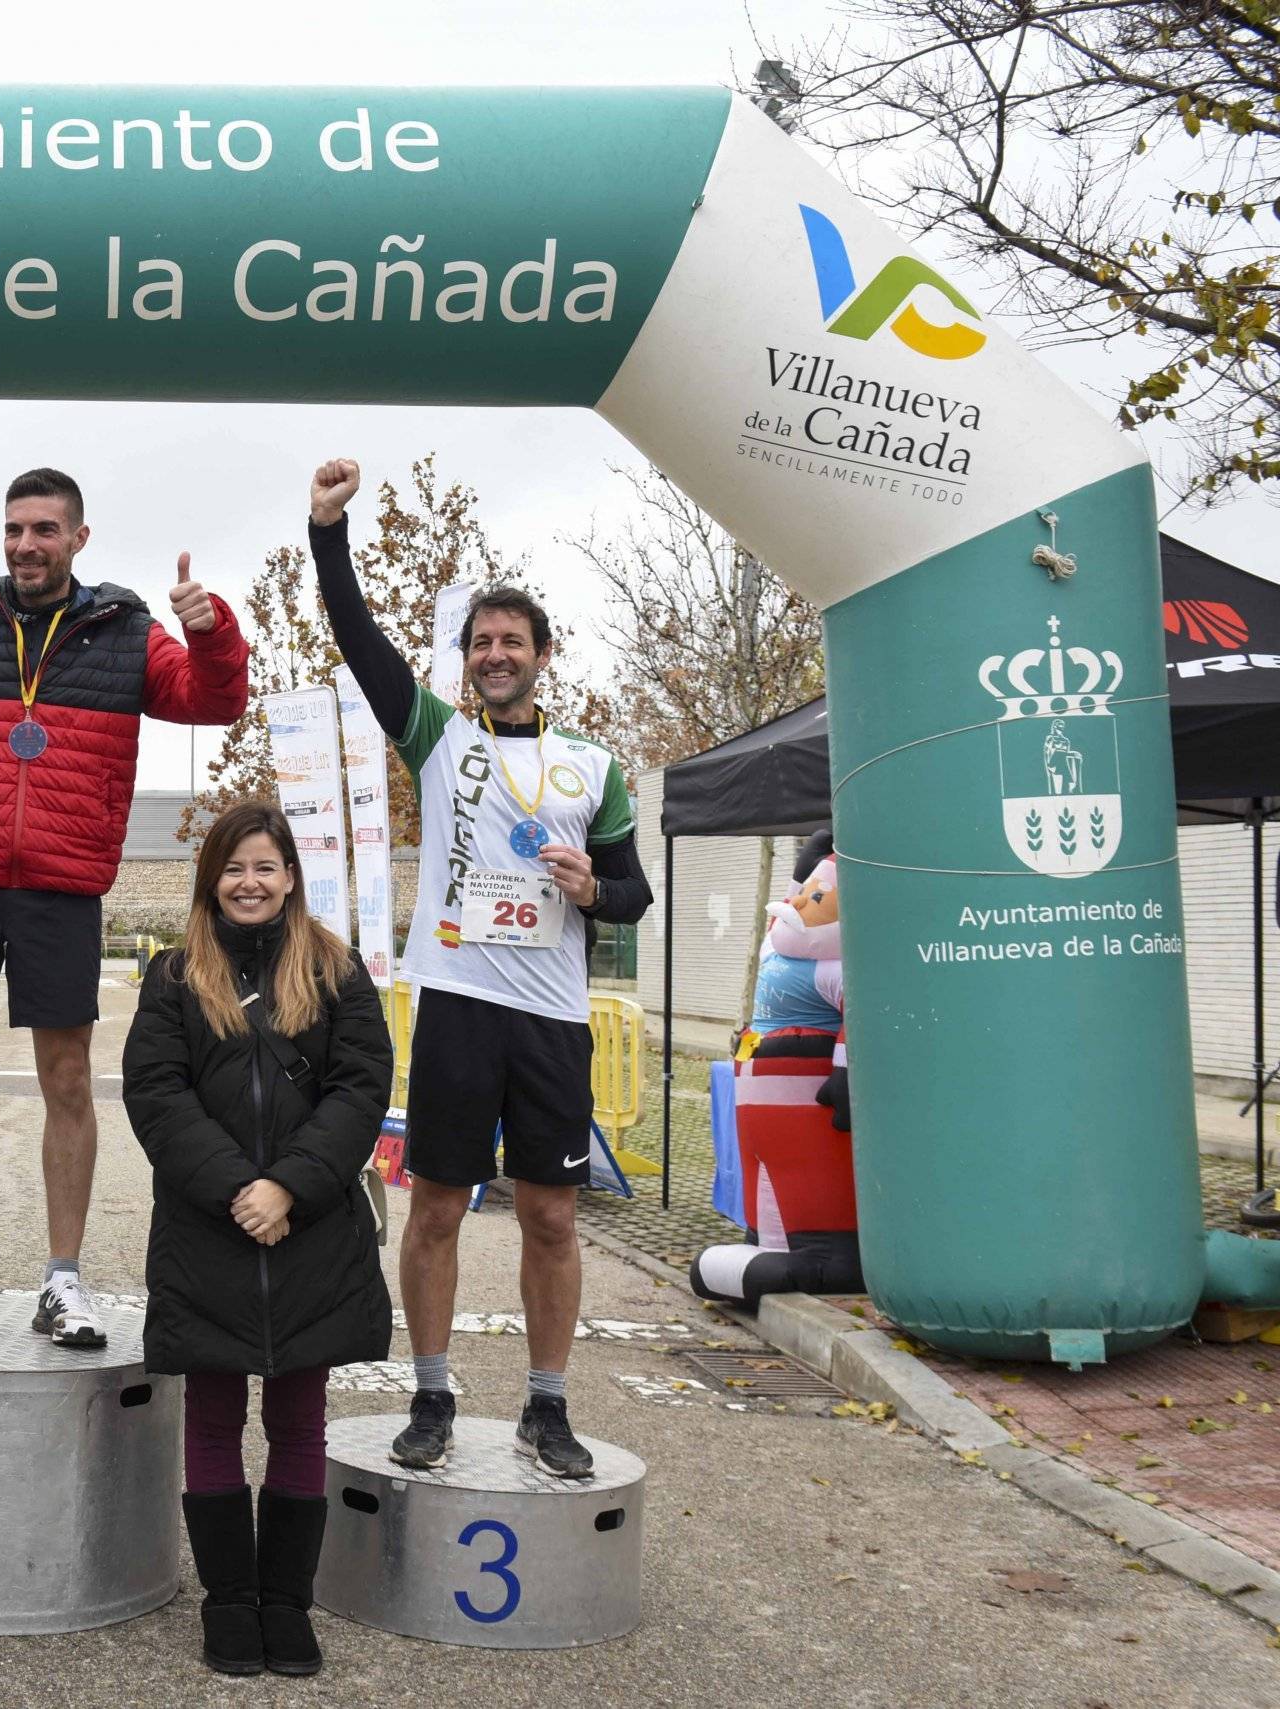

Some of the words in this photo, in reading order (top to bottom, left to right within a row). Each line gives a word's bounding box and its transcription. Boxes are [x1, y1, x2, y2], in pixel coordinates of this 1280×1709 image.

[319, 107, 440, 172] de
[107, 236, 184, 321] la
[233, 234, 618, 322] Cañada
[766, 346, 981, 431] Villanueva
[744, 410, 770, 432] de
[773, 416, 793, 438] la
[804, 406, 971, 476] Cañada
[736, 443, 902, 494] SENCILLAMENTE
[911, 483, 964, 507] TODO
[469, 881, 513, 891] NAVIDAD
[469, 890, 520, 900] SOLIDARIA
[483, 873, 526, 883] CARRERA
[493, 900, 538, 929] 26
[958, 899, 1136, 931] Ayuntamiento
[1142, 898, 1163, 919] de
[917, 940, 1054, 963] Villanueva
[1063, 935, 1095, 957] de
[1103, 934, 1122, 956] la
[1129, 932, 1183, 955] Cañada
[454, 1519, 521, 1623] 3
